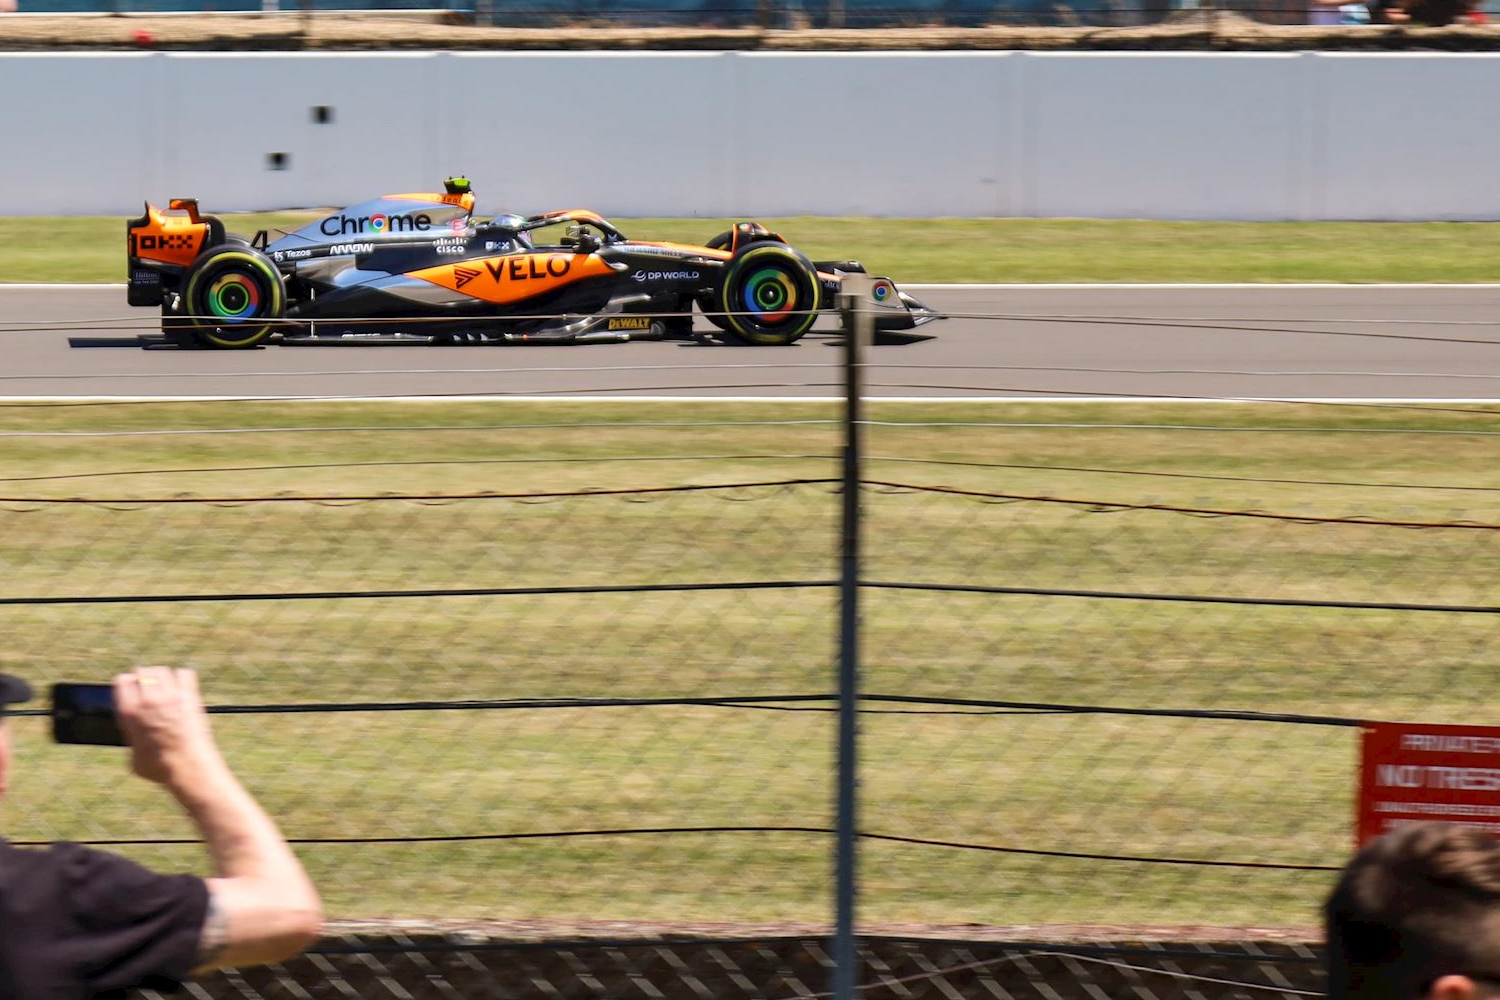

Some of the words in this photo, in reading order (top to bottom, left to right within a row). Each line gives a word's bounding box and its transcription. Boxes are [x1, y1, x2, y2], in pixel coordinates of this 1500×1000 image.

[320, 214, 431, 236] Chrome
[141, 235, 193, 249] OKX
[330, 243, 373, 255] ARROW
[285, 249, 312, 258] Tezos
[484, 255, 571, 283] VELO
[648, 271, 662, 280] DP
[663, 271, 700, 280] WORLD
[1375, 764, 1421, 788] NO
